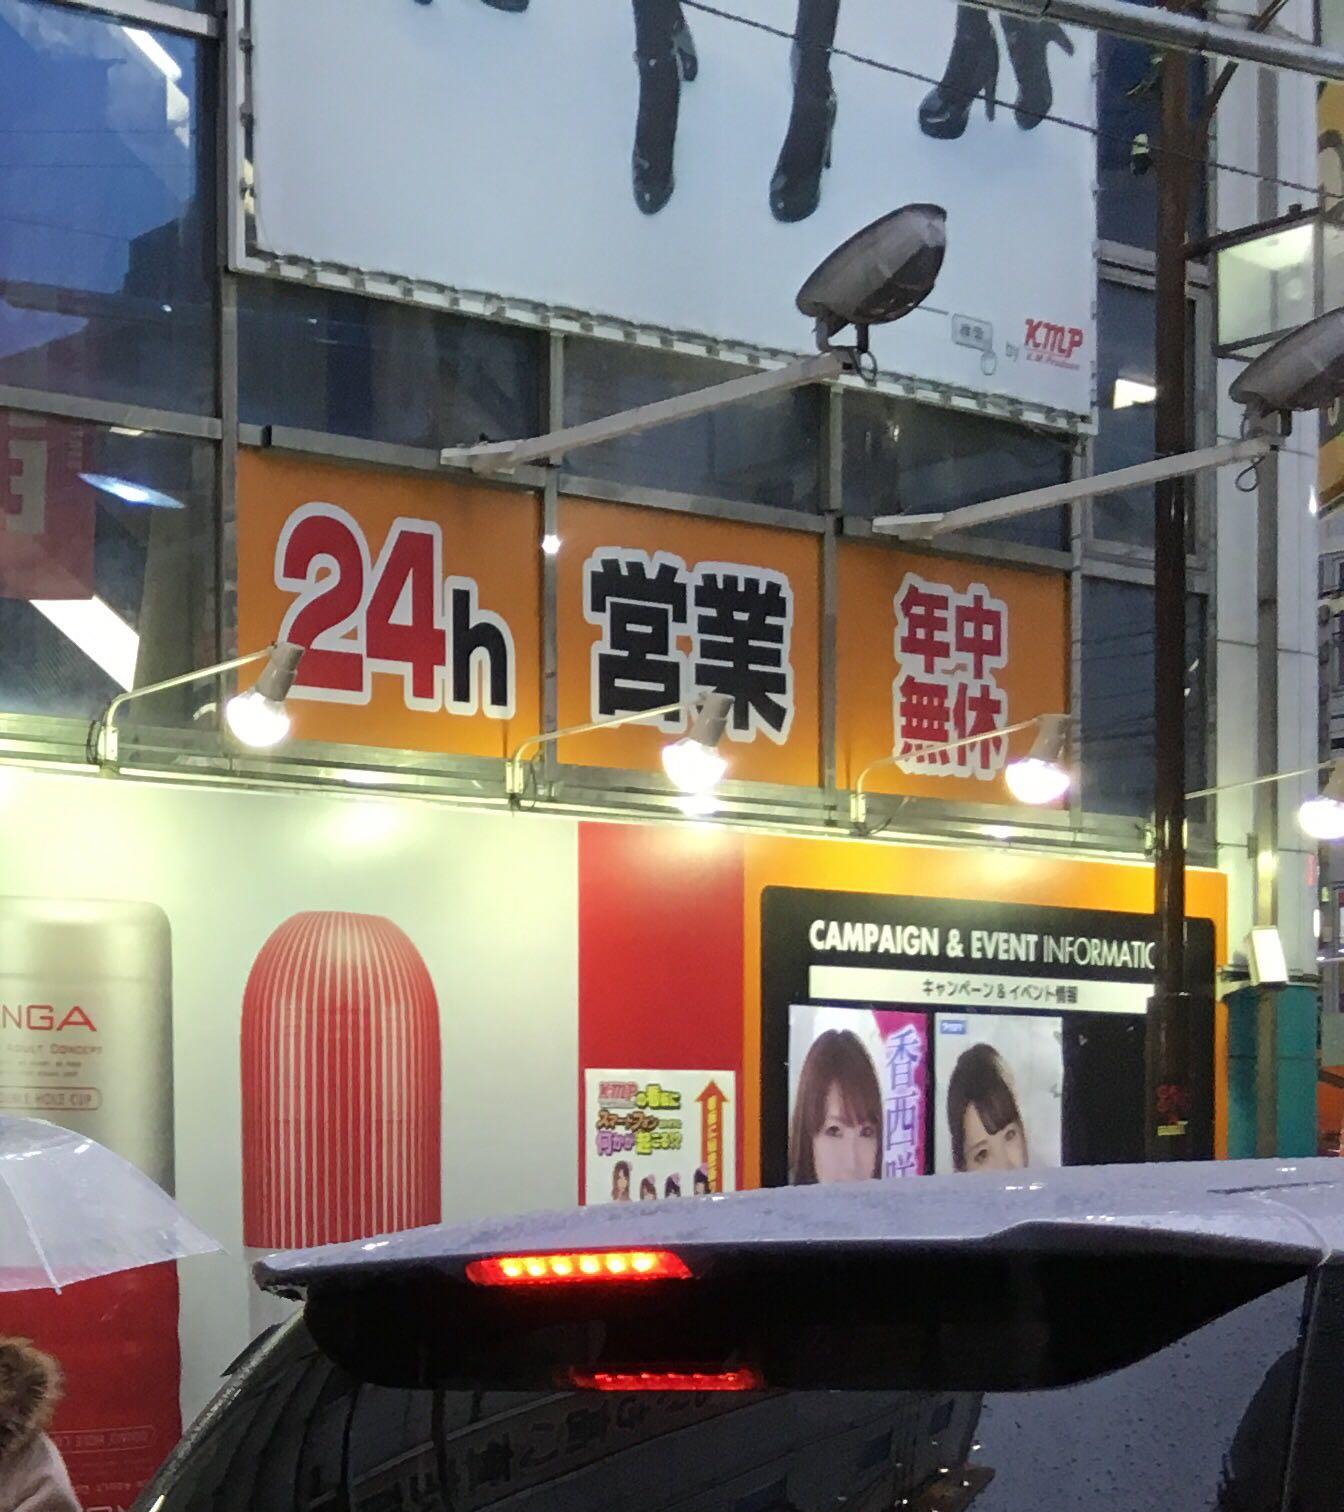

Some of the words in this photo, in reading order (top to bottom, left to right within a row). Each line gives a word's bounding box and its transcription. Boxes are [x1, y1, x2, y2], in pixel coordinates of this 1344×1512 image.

[1024, 318, 1084, 359] KMP
[279, 504, 512, 714] 24h
[588, 552, 790, 741] 営業
[899, 577, 1007, 669] 年中
[897, 673, 1007, 775] 無休
[809, 919, 939, 957] CAMPAIGN
[945, 932, 964, 959] &
[970, 930, 1038, 963] EVENT
[1043, 935, 1155, 970] INFORMATIO
